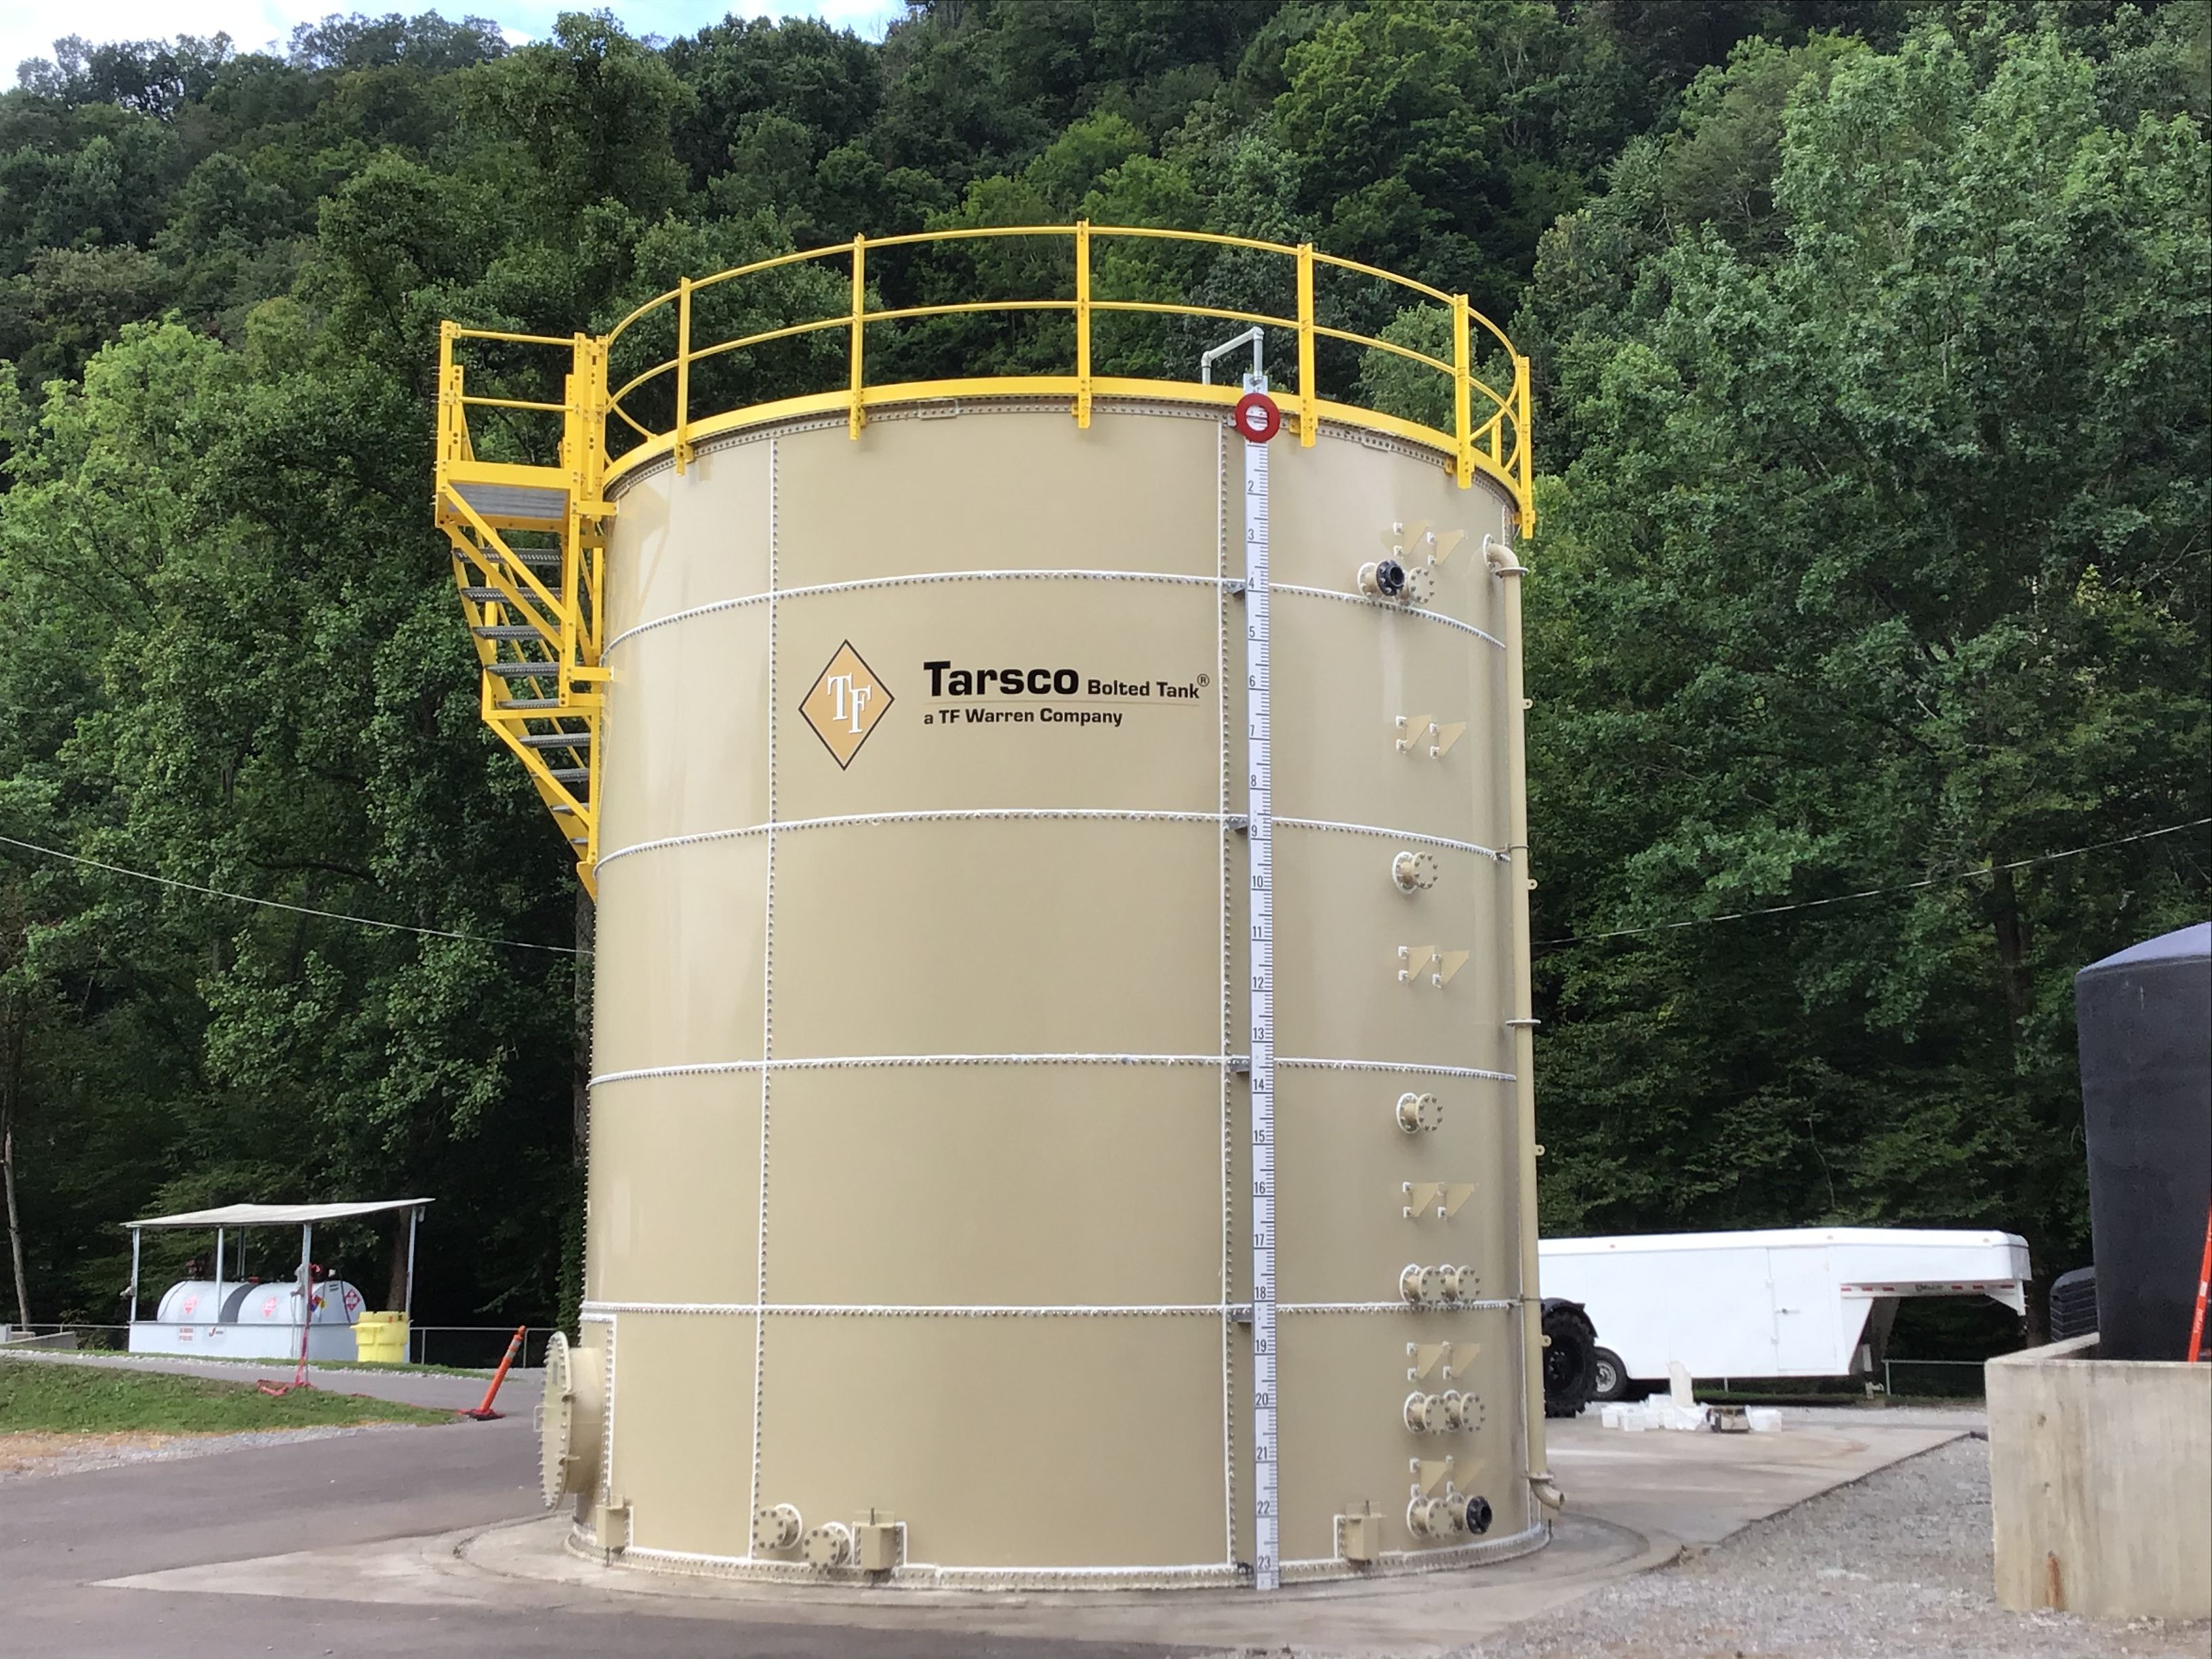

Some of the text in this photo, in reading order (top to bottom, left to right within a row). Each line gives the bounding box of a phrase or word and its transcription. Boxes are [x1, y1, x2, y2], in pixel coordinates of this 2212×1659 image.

[1247, 480, 1254, 492] 2
[1248, 529, 1254, 540] 3
[1248, 577, 1255, 588] 4
[1249, 626, 1255, 637] 5
[923, 660, 1079, 697] Tarsco
[1088, 679, 1150, 697] Bolted
[1249, 675, 1256, 687] 6
[827, 672, 872, 735] TF
[924, 708, 1123, 727] a TF Warren Company
[1249, 724, 1255, 736] 7
[1250, 775, 1256, 786] 8
[1251, 825, 1257, 837] 9
[1252, 876, 1263, 888] 10
[1252, 926, 1262, 938] 11
[1253, 977, 1264, 989] 12
[1253, 1027, 1265, 1040] 13
[1253, 1079, 1265, 1090] 14
[1254, 1130, 1265, 1142] 15
[1254, 1181, 1266, 1193] 16
[1254, 1234, 1265, 1246] 17
[1255, 1286, 1267, 1299] 18
[1256, 1339, 1267, 1352] 19
[1256, 1393, 1268, 1406] 20
[1257, 1447, 1267, 1460] 21
[1257, 1501, 1269, 1514] 22
[1258, 1555, 1271, 1569] 23
